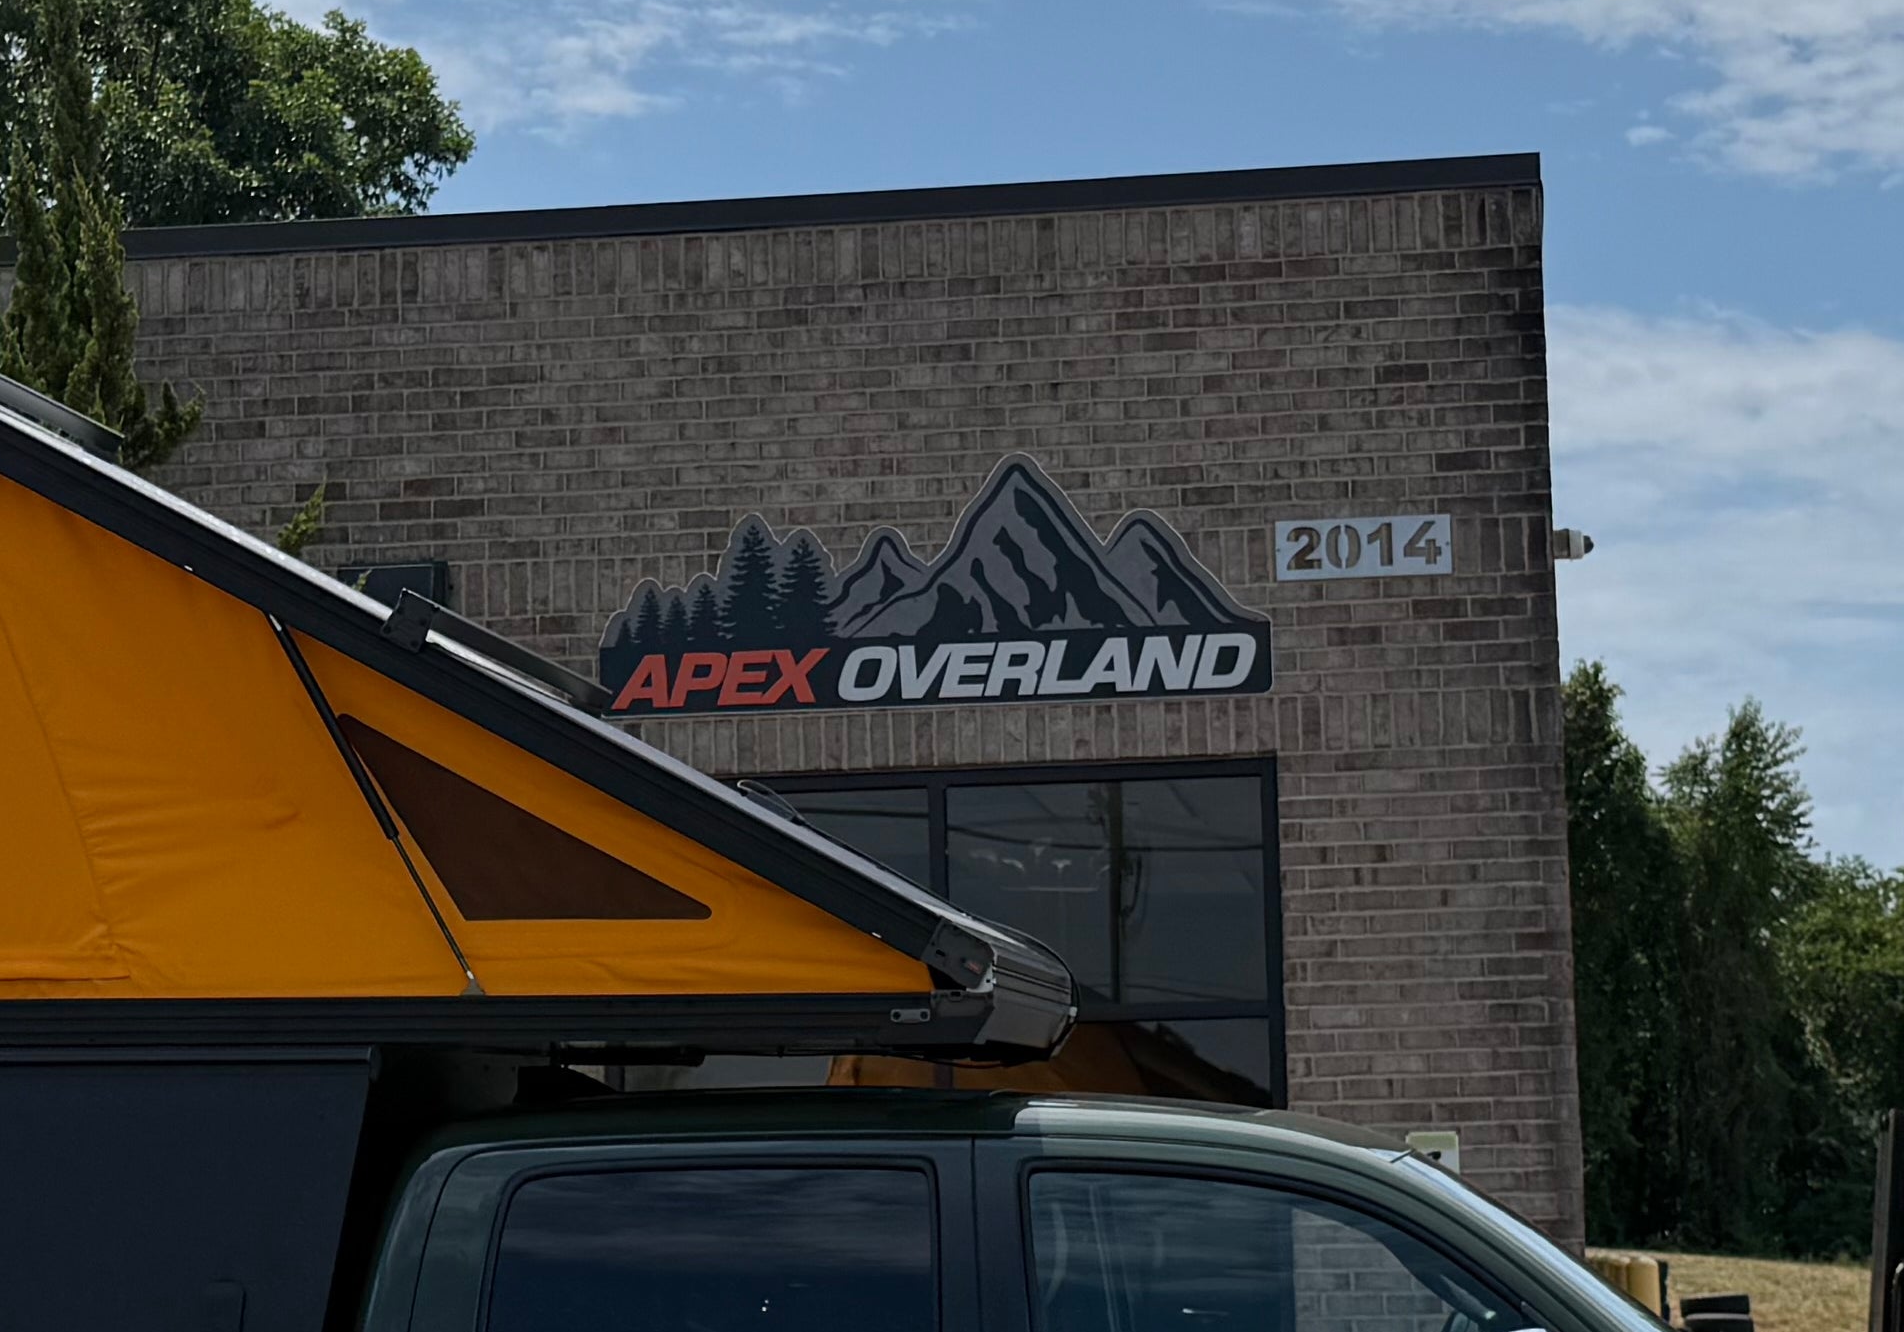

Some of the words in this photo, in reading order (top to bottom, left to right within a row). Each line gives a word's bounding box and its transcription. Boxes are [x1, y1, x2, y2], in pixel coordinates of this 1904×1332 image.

[1286, 521, 1443, 571] 2014
[611, 647, 831, 710] APEX
[838, 633, 1257, 702] OVERLAND
